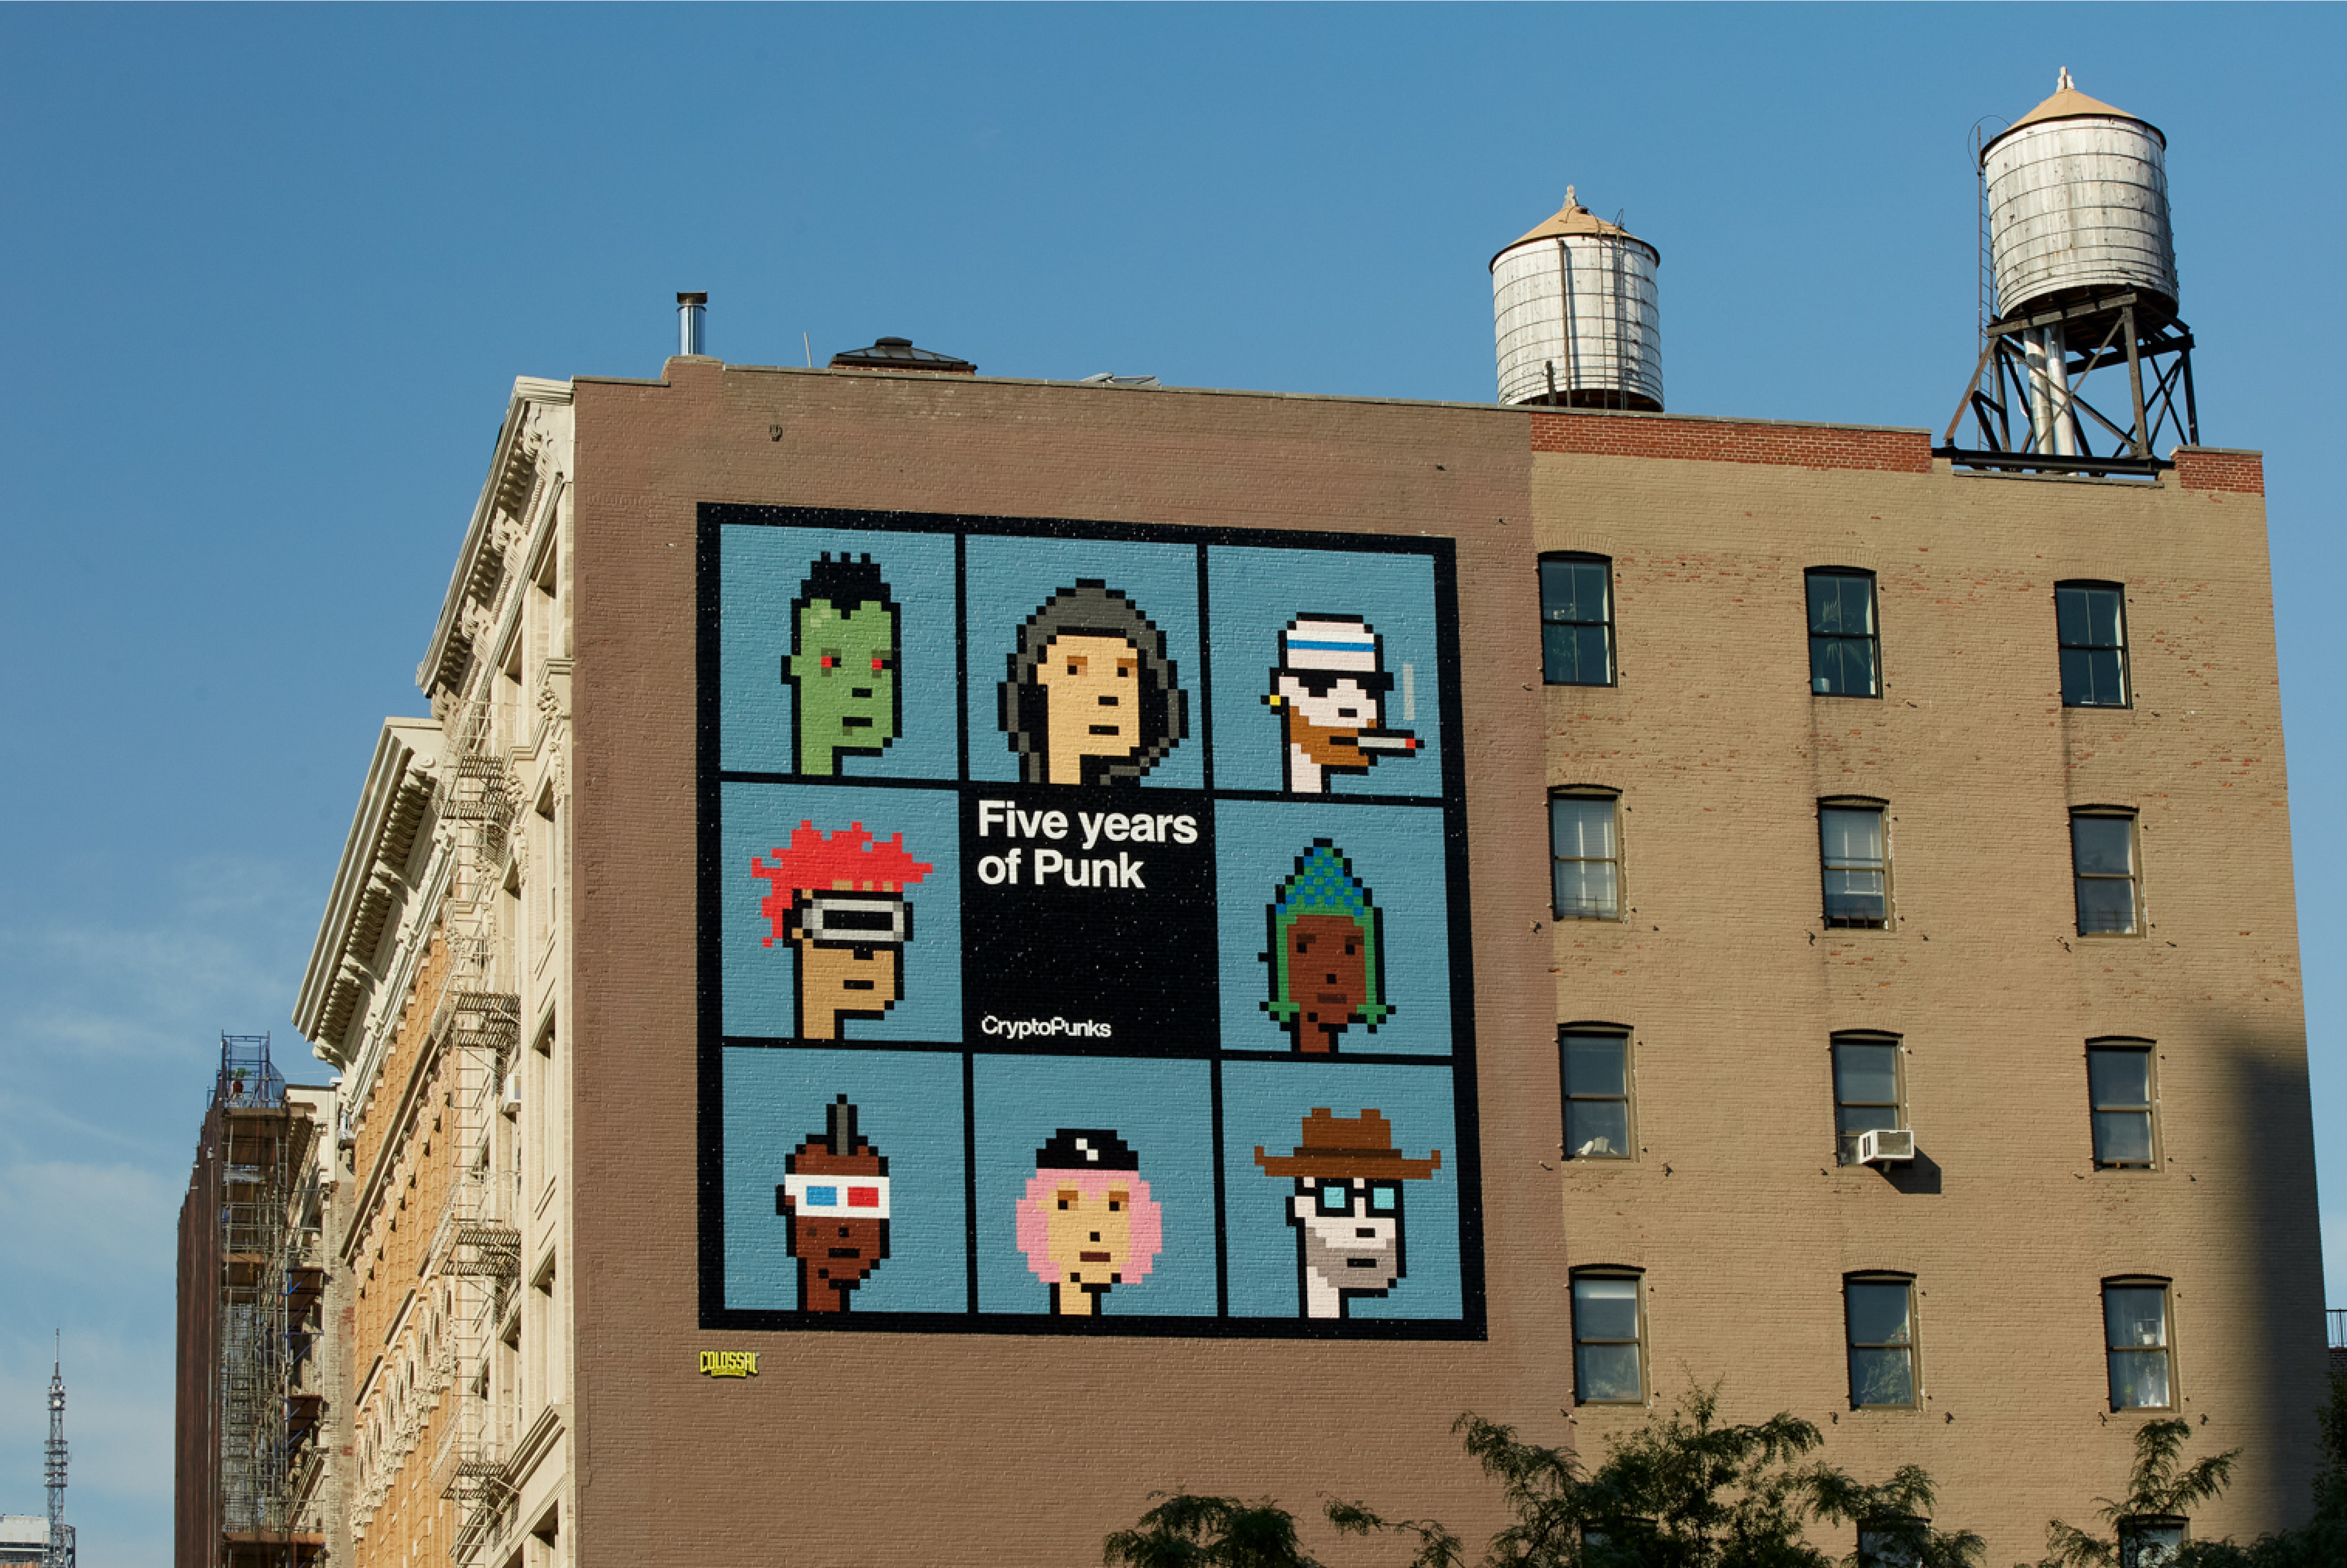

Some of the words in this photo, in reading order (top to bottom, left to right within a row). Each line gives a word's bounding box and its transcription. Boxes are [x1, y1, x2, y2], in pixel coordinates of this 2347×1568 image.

[979, 800, 1068, 840] Five
[1078, 813, 1198, 849] years
[977, 848, 1022, 885] of
[1035, 849, 1145, 888] Punk
[981, 1015, 1111, 1039] CryptoPunks
[700, 1351, 760, 1373] COLOSSAL
